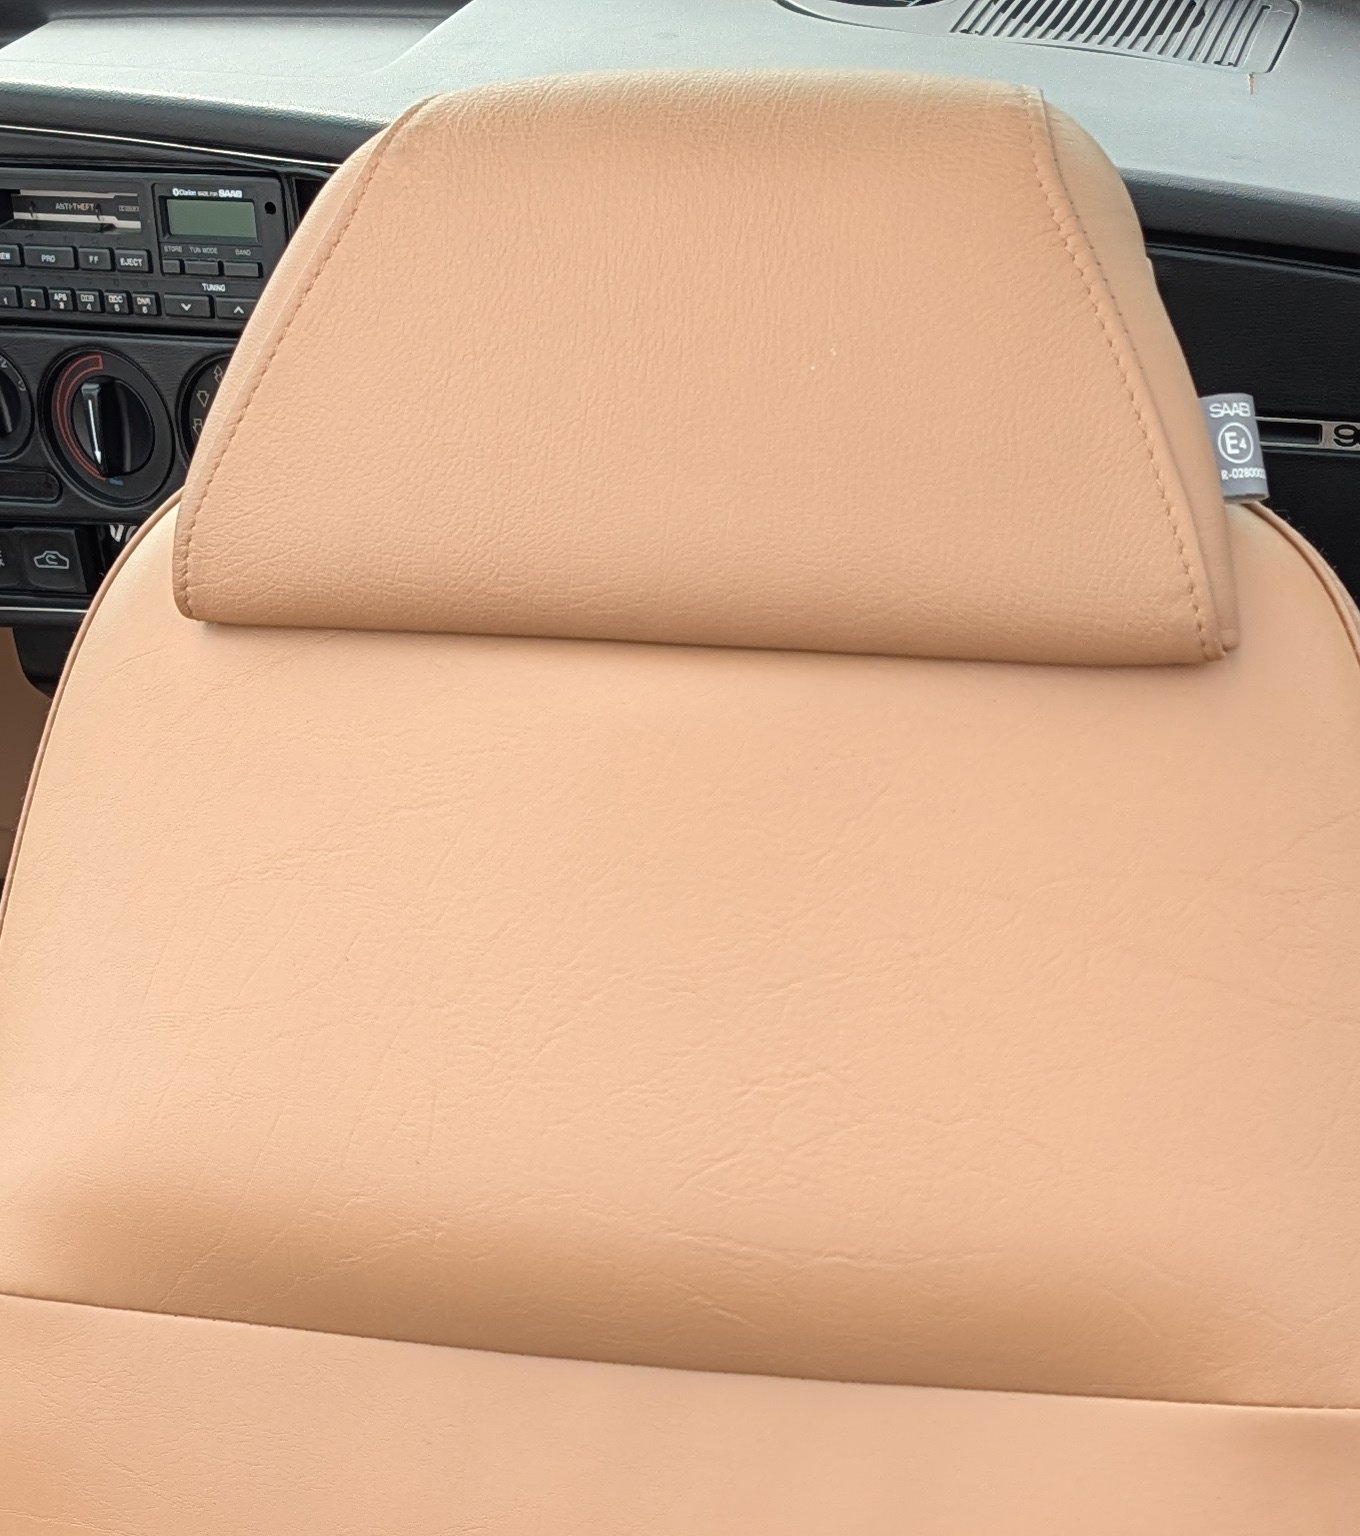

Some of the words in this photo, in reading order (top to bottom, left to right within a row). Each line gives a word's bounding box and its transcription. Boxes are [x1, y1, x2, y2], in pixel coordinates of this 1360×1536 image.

[218, 189, 243, 198] SAAB
[120, 257, 143, 267] EJECT
[202, 283, 226, 292] TUNING
[30, 299, 36, 307] 2
[1209, 402, 1252, 418] SAAB
